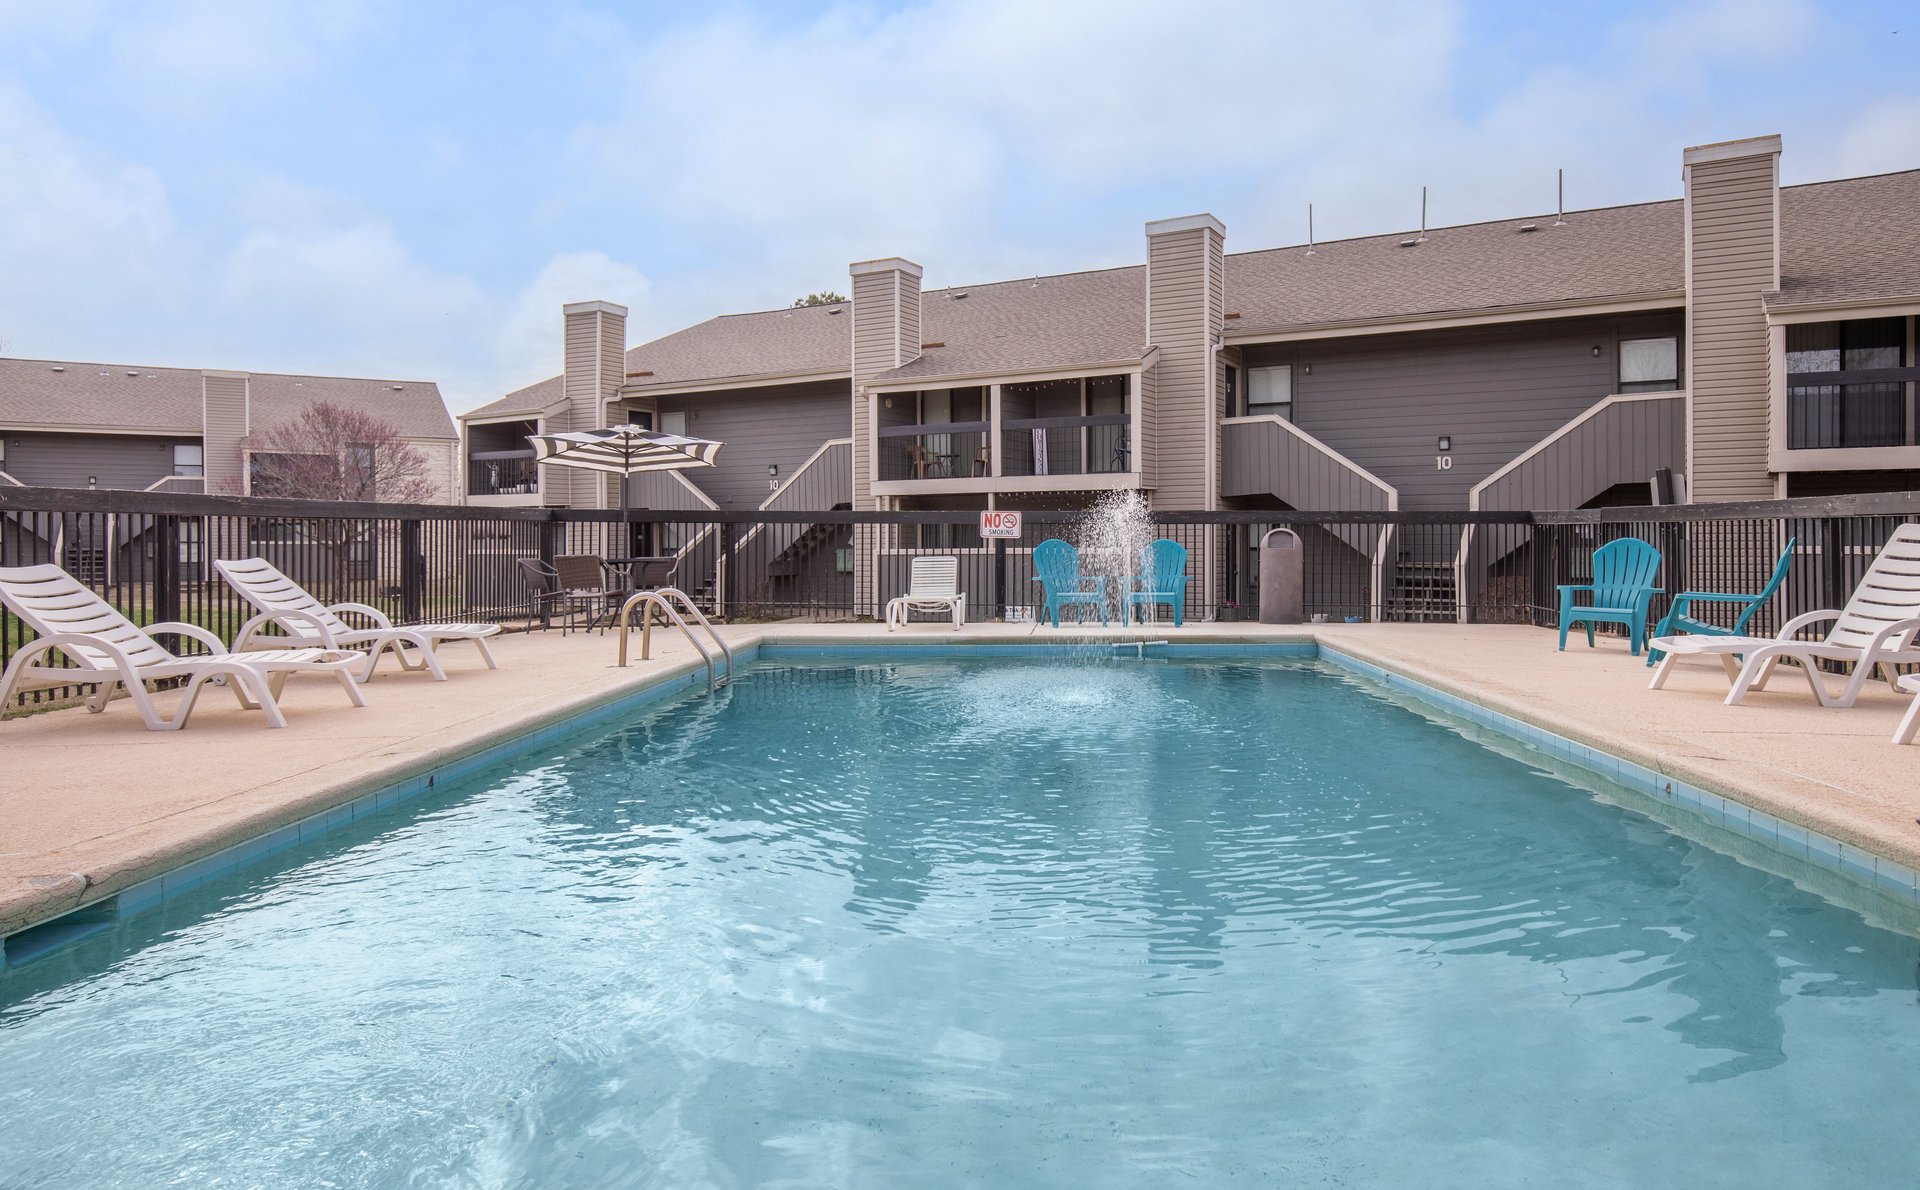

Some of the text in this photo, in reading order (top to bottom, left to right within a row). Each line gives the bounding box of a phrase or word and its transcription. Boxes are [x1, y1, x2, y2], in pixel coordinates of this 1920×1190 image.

[1435, 456, 1452, 470] 10
[769, 479, 779, 491] 10
[984, 513, 1001, 528] NO
